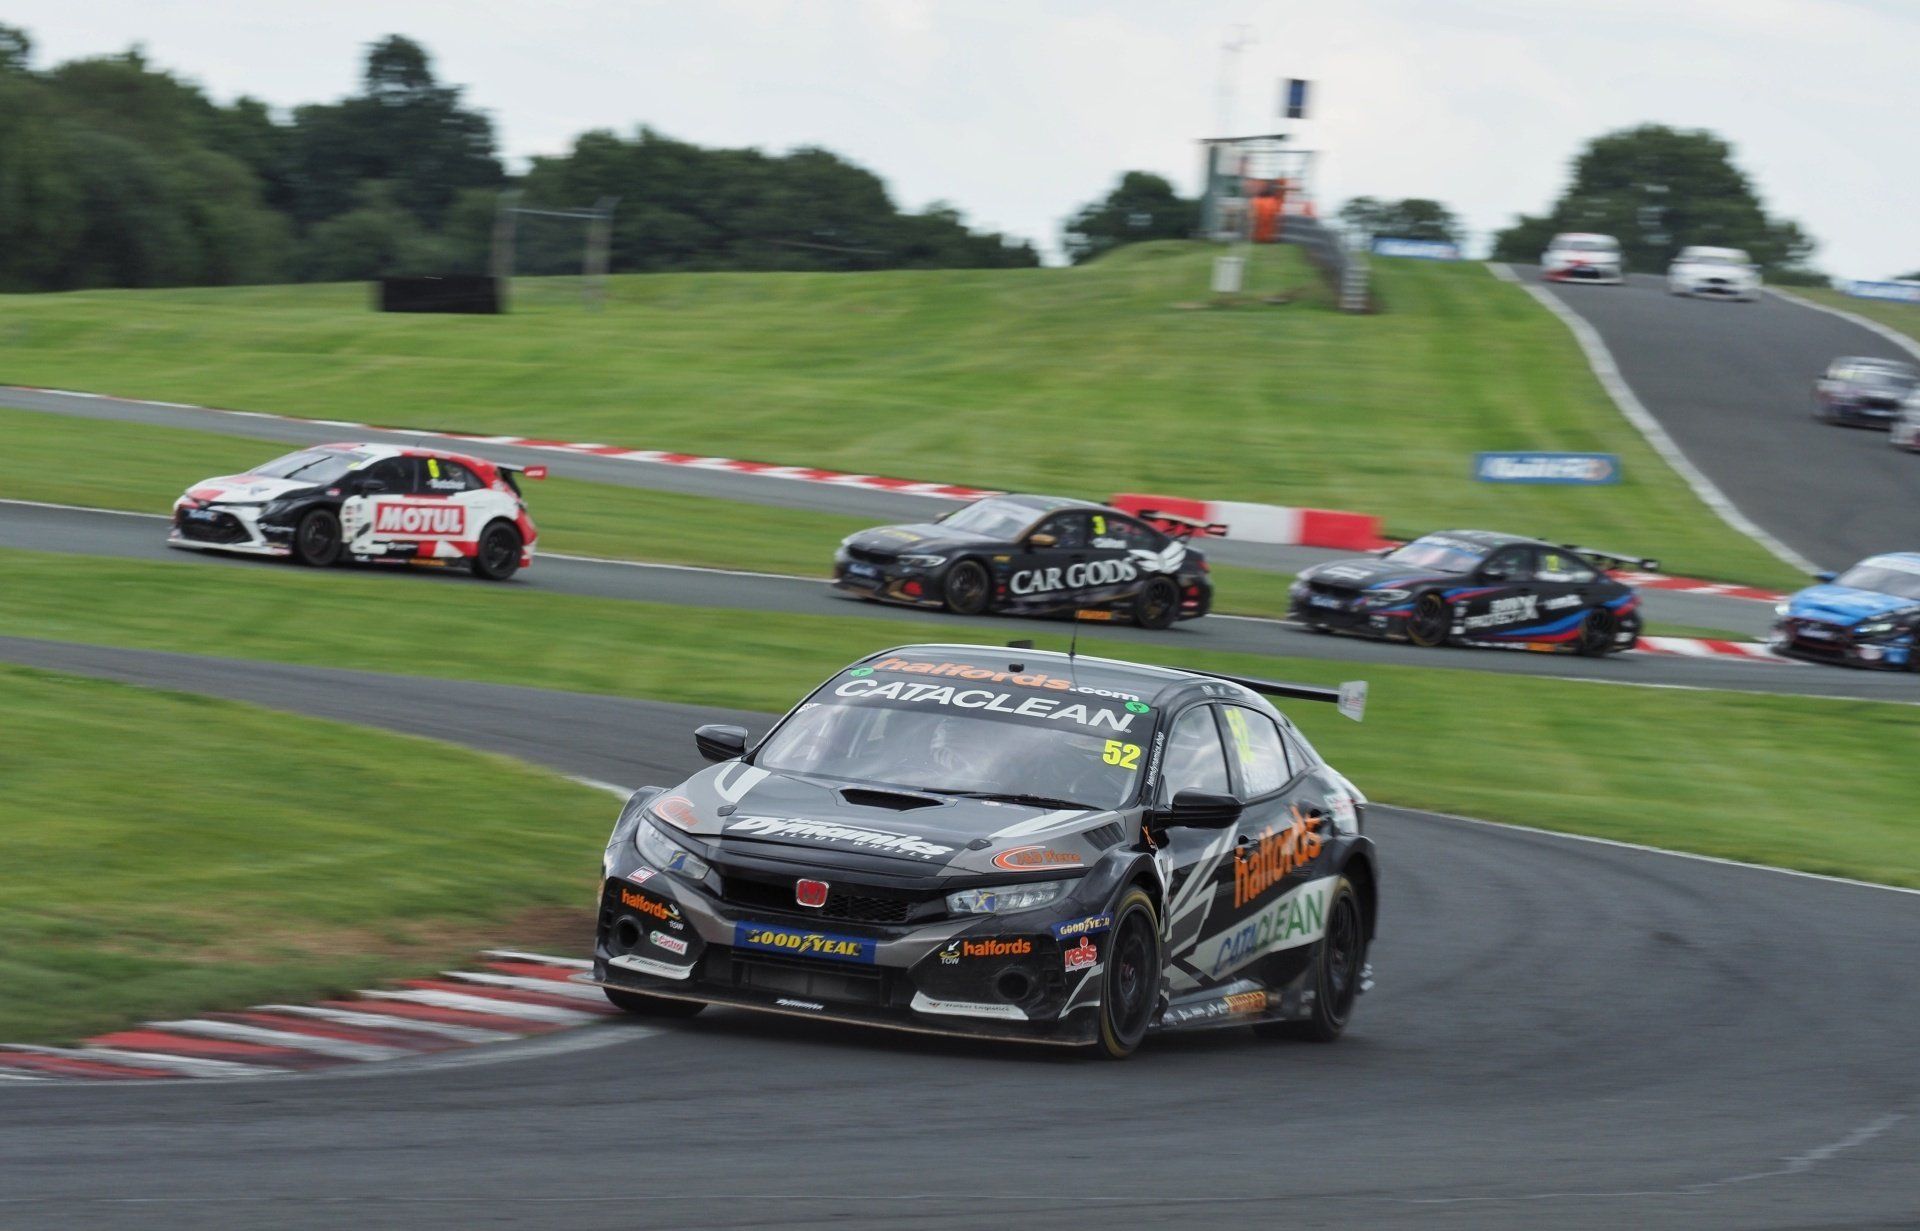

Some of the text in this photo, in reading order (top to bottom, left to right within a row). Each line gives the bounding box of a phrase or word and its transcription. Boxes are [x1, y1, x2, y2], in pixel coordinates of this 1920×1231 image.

[378, 506, 463, 532] MOTUL
[1010, 559, 1137, 594] CAR GODS
[872, 657, 1139, 702] halfords.com
[835, 679, 1135, 732] CATACLEAN
[1102, 739, 1141, 770] 52
[621, 888, 668, 920] halfords
[963, 938, 1032, 957] halfords
